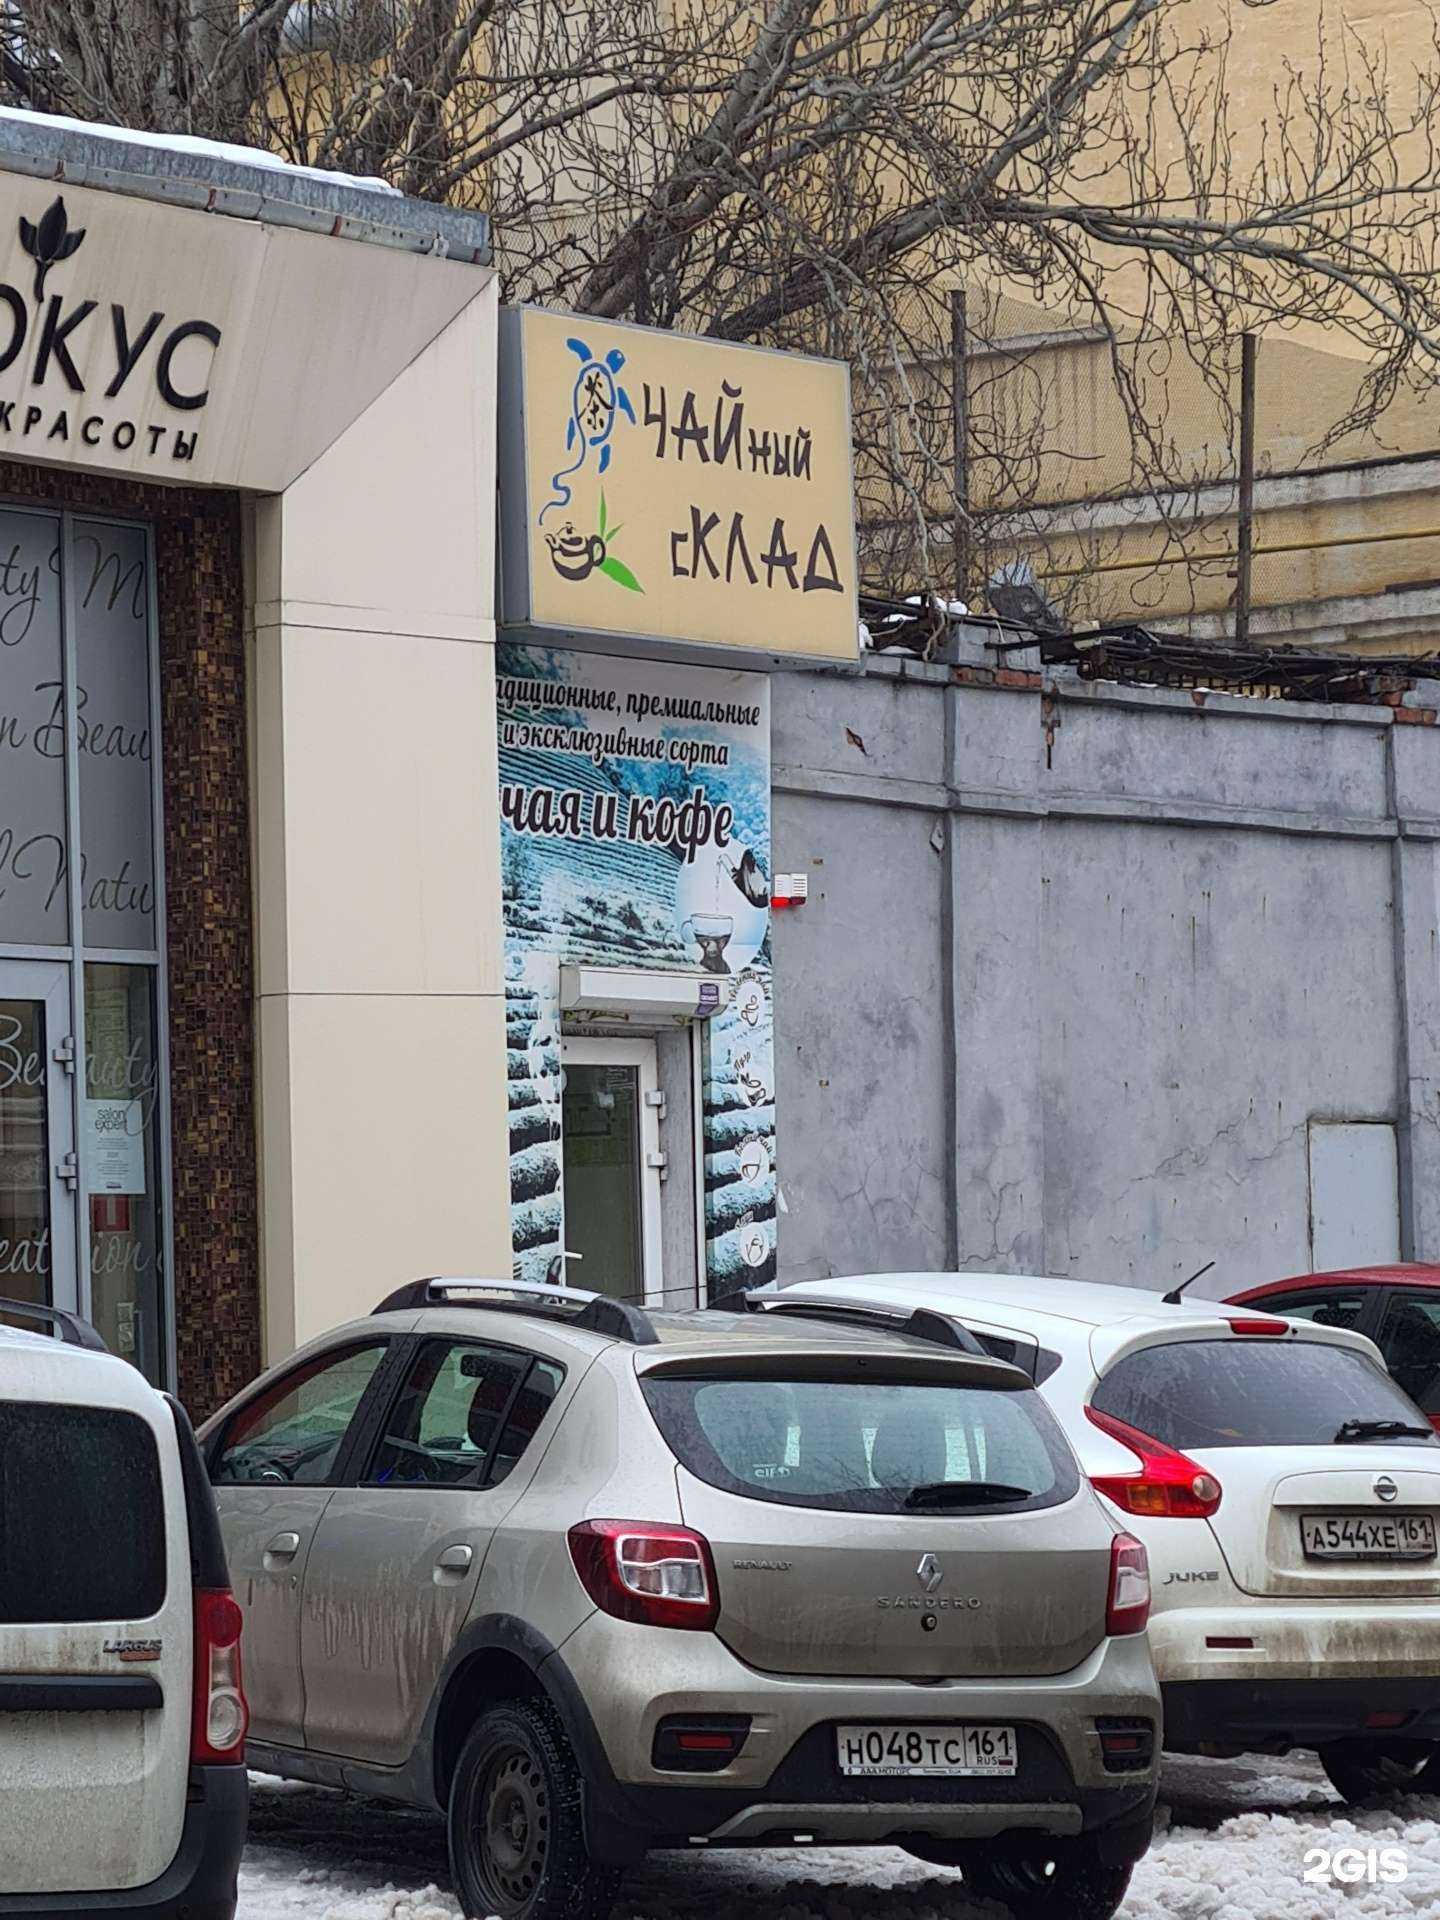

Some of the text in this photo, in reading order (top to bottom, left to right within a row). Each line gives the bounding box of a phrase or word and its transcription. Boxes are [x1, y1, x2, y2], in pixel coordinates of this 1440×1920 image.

[0, 399, 198, 461] КРАСОТЫ
[626, 692, 761, 726] премиальные
[503, 723, 729, 770] и эксклюзивные сорта
[502, 786, 732, 864] чая и кофе
[733, 1559, 793, 1571] RENAULT
[1163, 1571, 1219, 1585] JUKE
[877, 1596, 981, 1610] SANDERO
[103, 1639, 163, 1653] LARGUS
[968, 1730, 1008, 1757] 161
